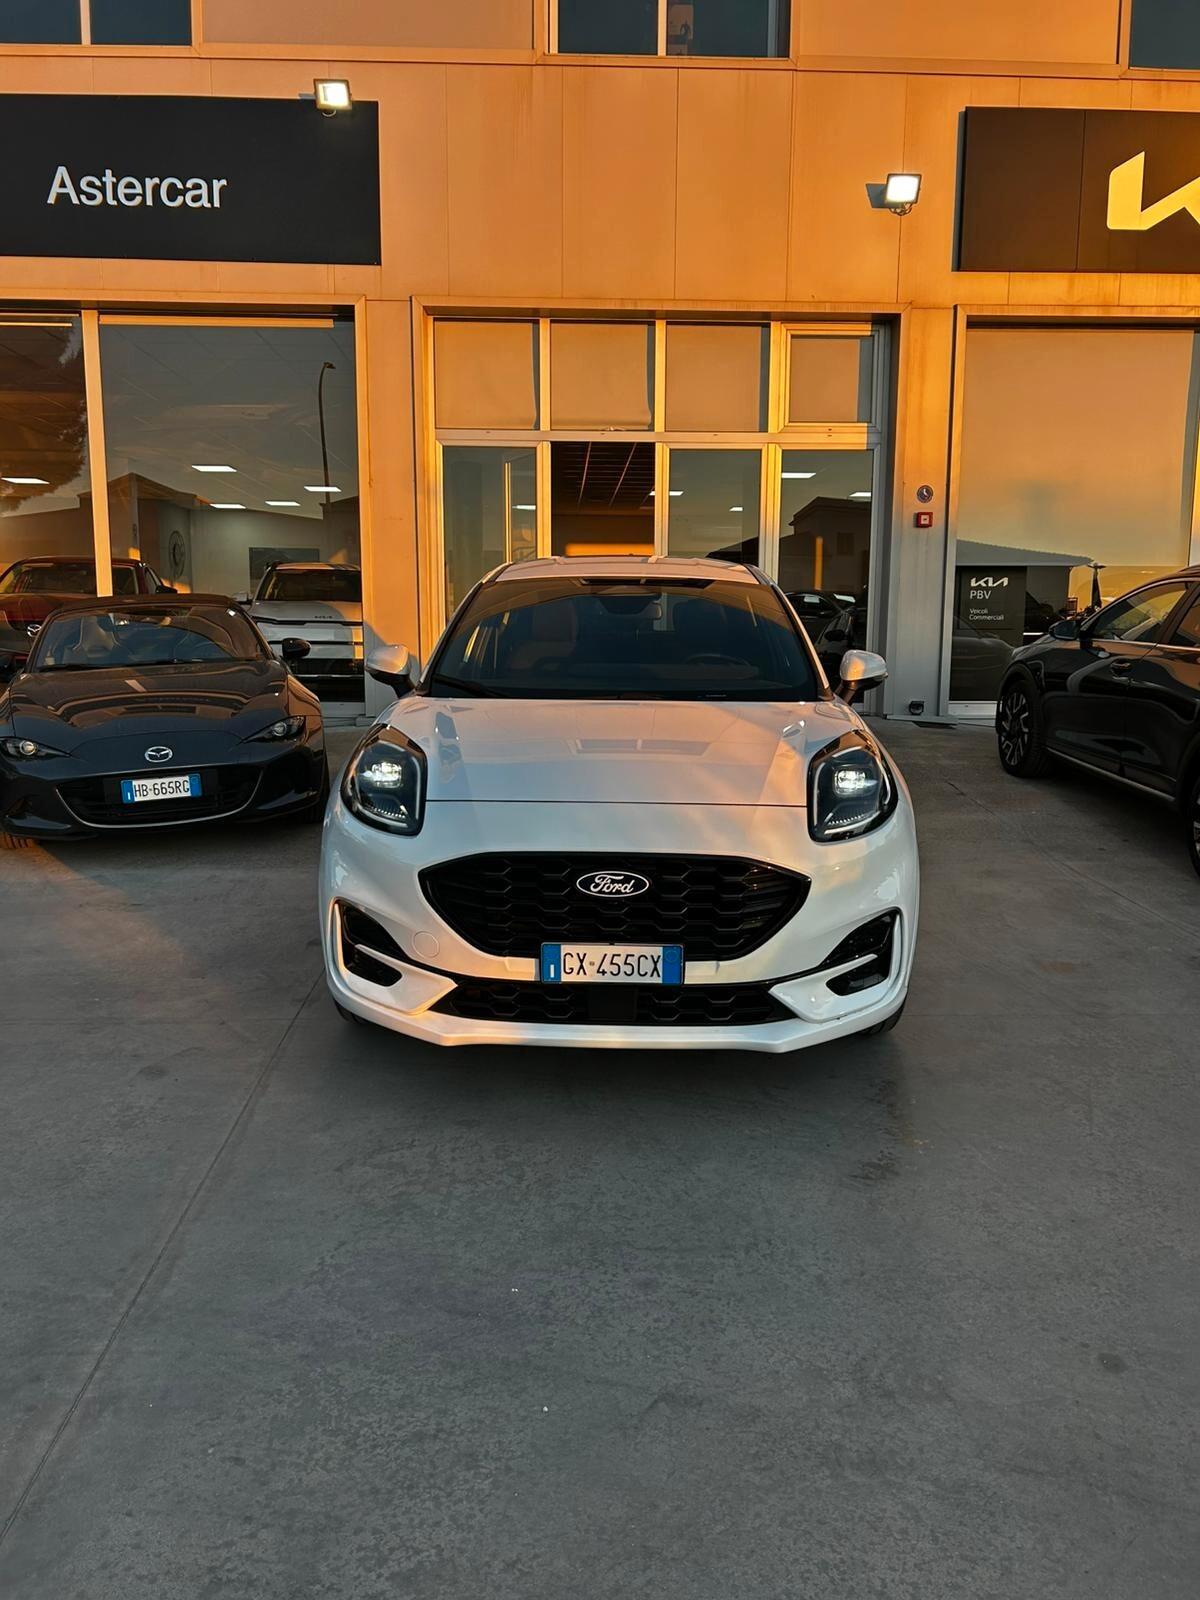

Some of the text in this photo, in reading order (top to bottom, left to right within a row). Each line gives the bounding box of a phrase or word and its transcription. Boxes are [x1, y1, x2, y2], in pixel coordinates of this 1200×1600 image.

[47, 165, 228, 209] Astercar
[970, 590, 992, 600] PBV
[590, 874, 635, 893] Ford
